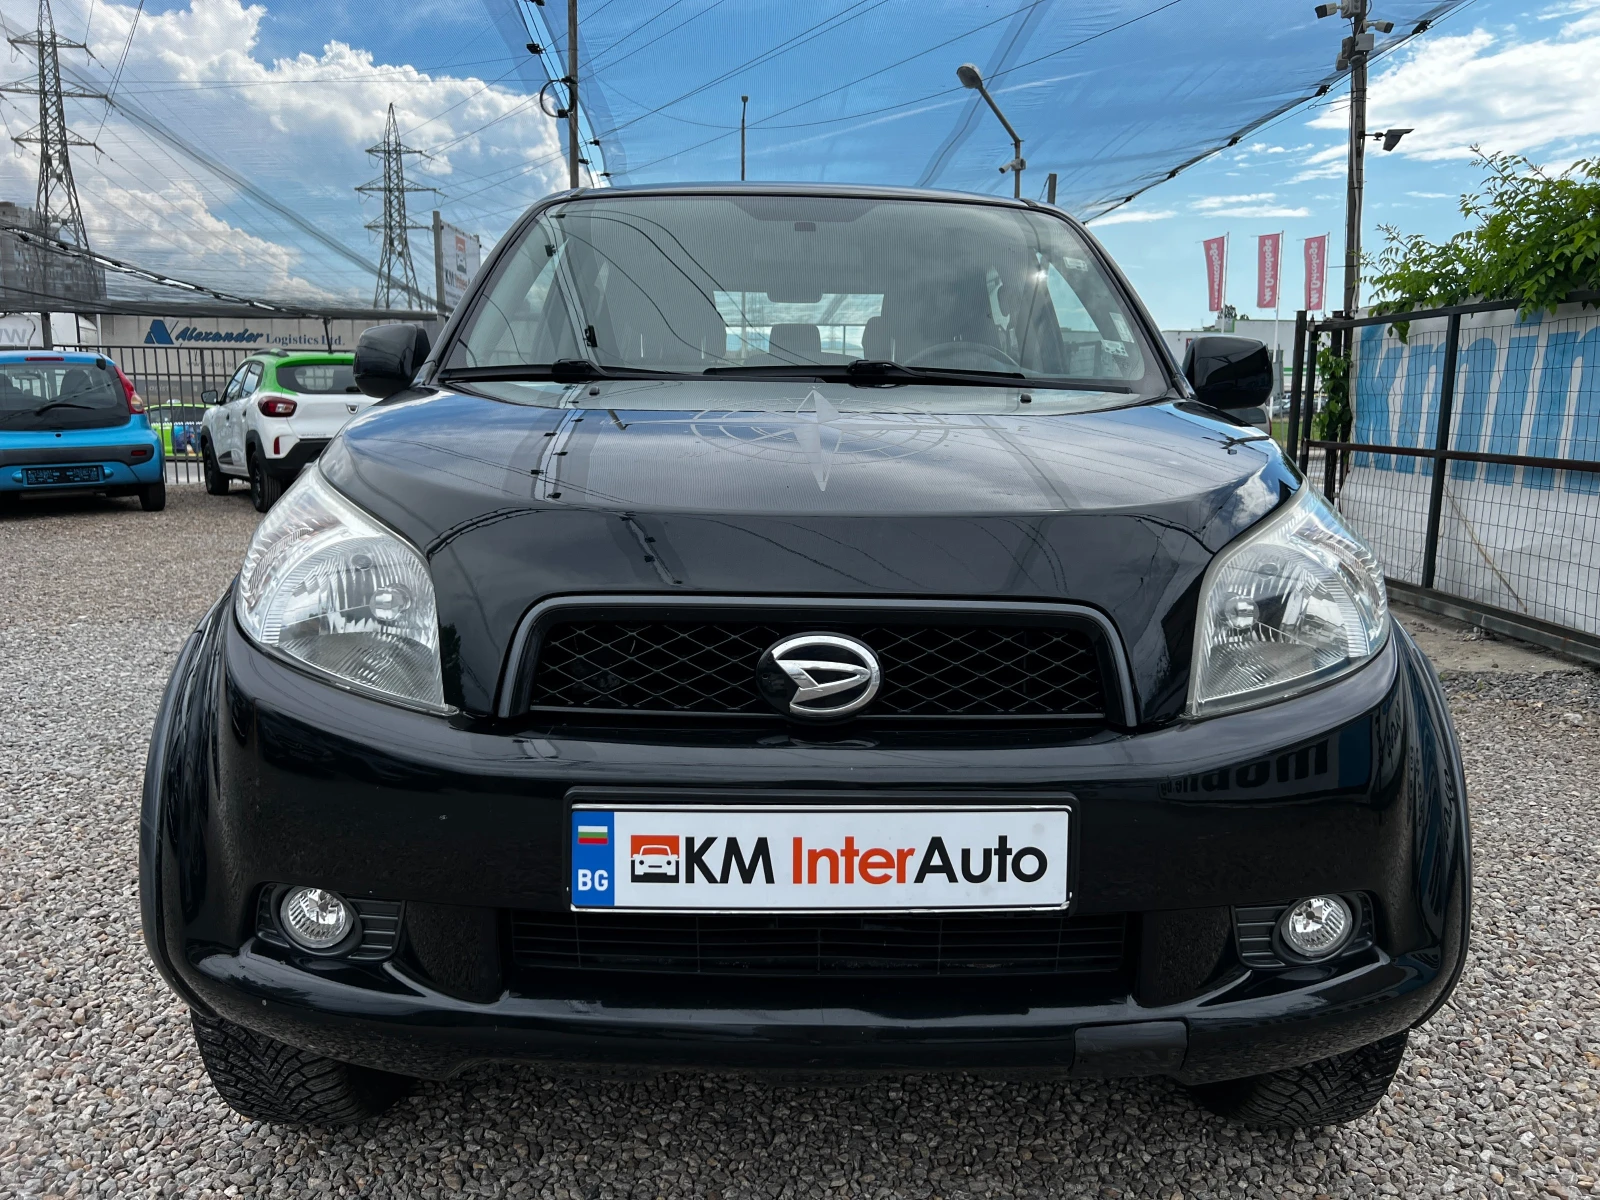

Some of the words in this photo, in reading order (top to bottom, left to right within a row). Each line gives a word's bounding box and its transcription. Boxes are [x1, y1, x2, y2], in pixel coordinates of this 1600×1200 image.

[175, 326, 264, 343] Alexander
[266, 333, 319, 346] Logistics
[685, 836, 775, 884] KM
[792, 835, 1047, 884] InterAuto
[577, 868, 609, 891] BG
